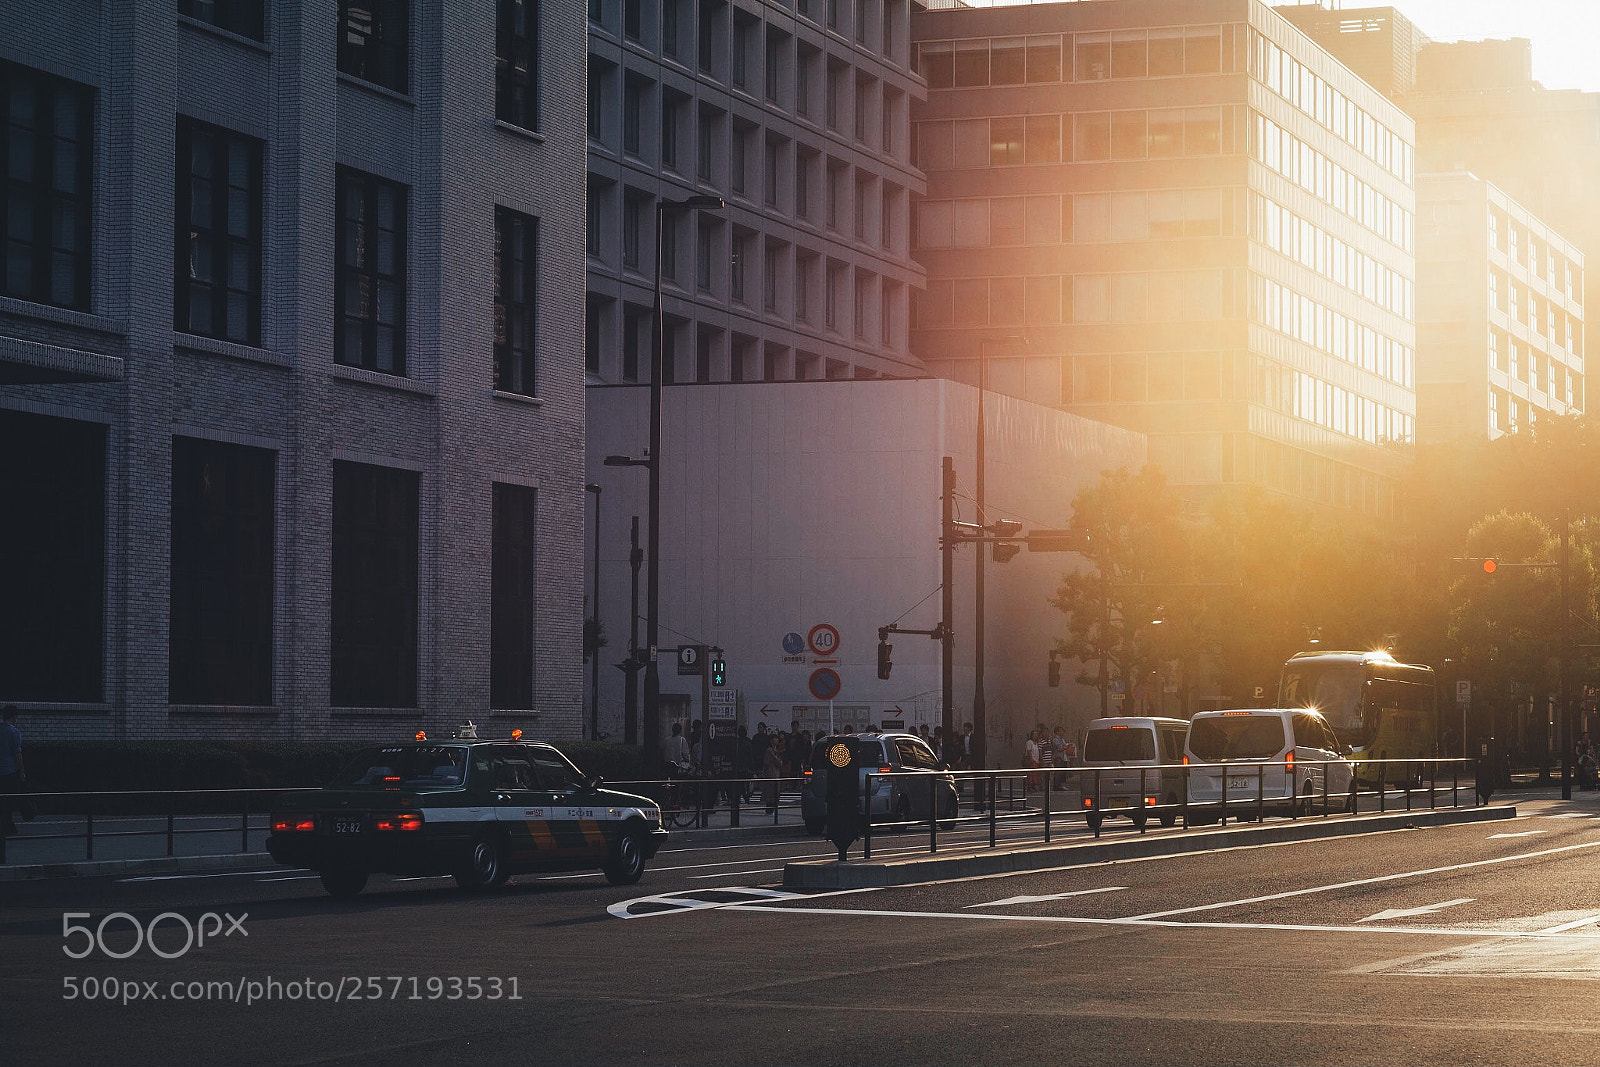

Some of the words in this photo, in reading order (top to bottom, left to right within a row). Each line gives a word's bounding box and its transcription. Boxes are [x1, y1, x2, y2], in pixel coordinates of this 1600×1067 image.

[815, 632, 833, 647] 40
[1254, 686, 1264, 696] P
[1459, 682, 1468, 693] P
[336, 822, 361, 833] 52-82
